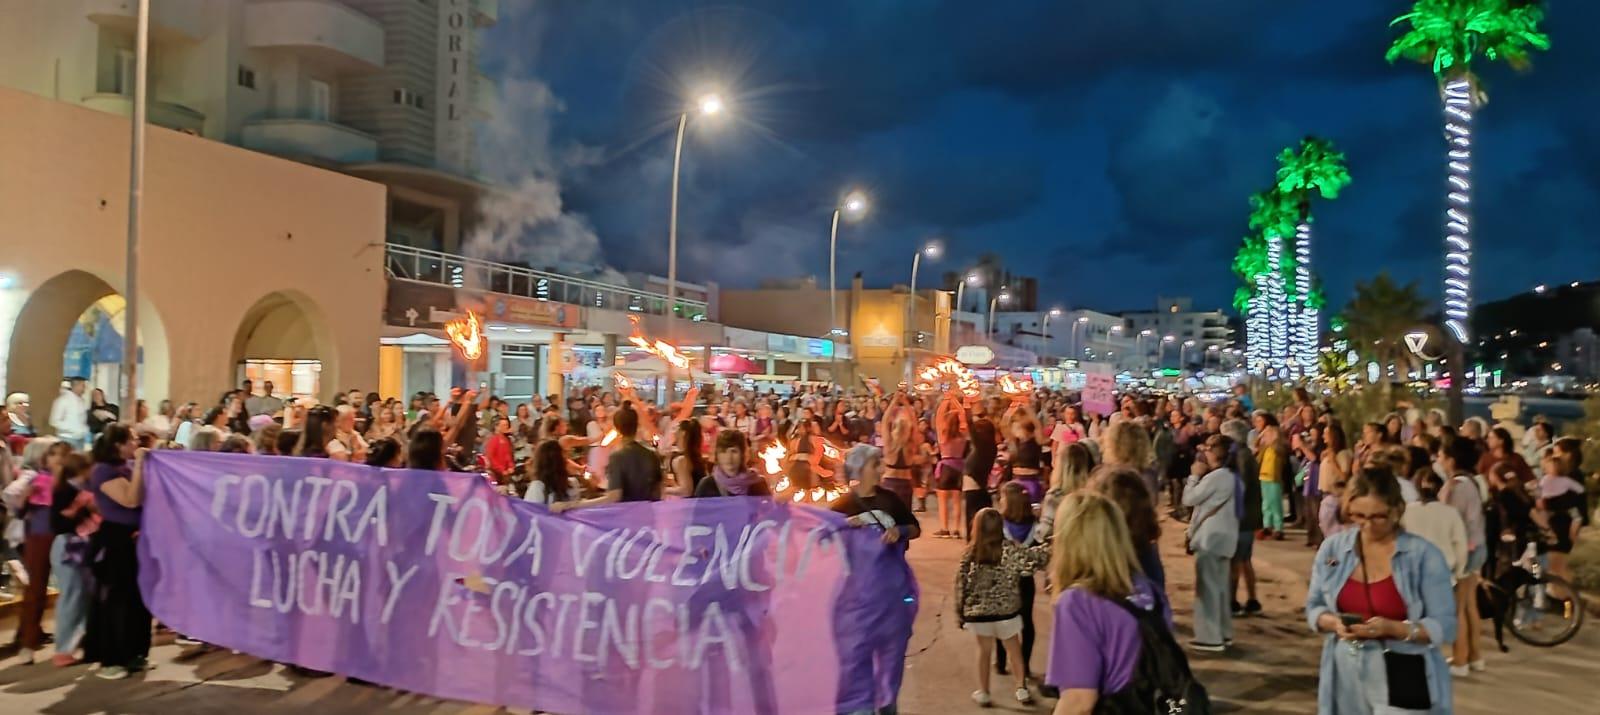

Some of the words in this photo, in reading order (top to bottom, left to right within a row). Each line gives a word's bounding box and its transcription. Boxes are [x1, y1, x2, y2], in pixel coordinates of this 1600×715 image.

[211, 474, 388, 547] CONTRA
[425, 493, 542, 576] TODA
[571, 519, 851, 592] VIOLENCIA
[249, 549, 361, 625] LUCHA
[380, 560, 420, 625] Y
[427, 572, 746, 672] RESISTENCIA
